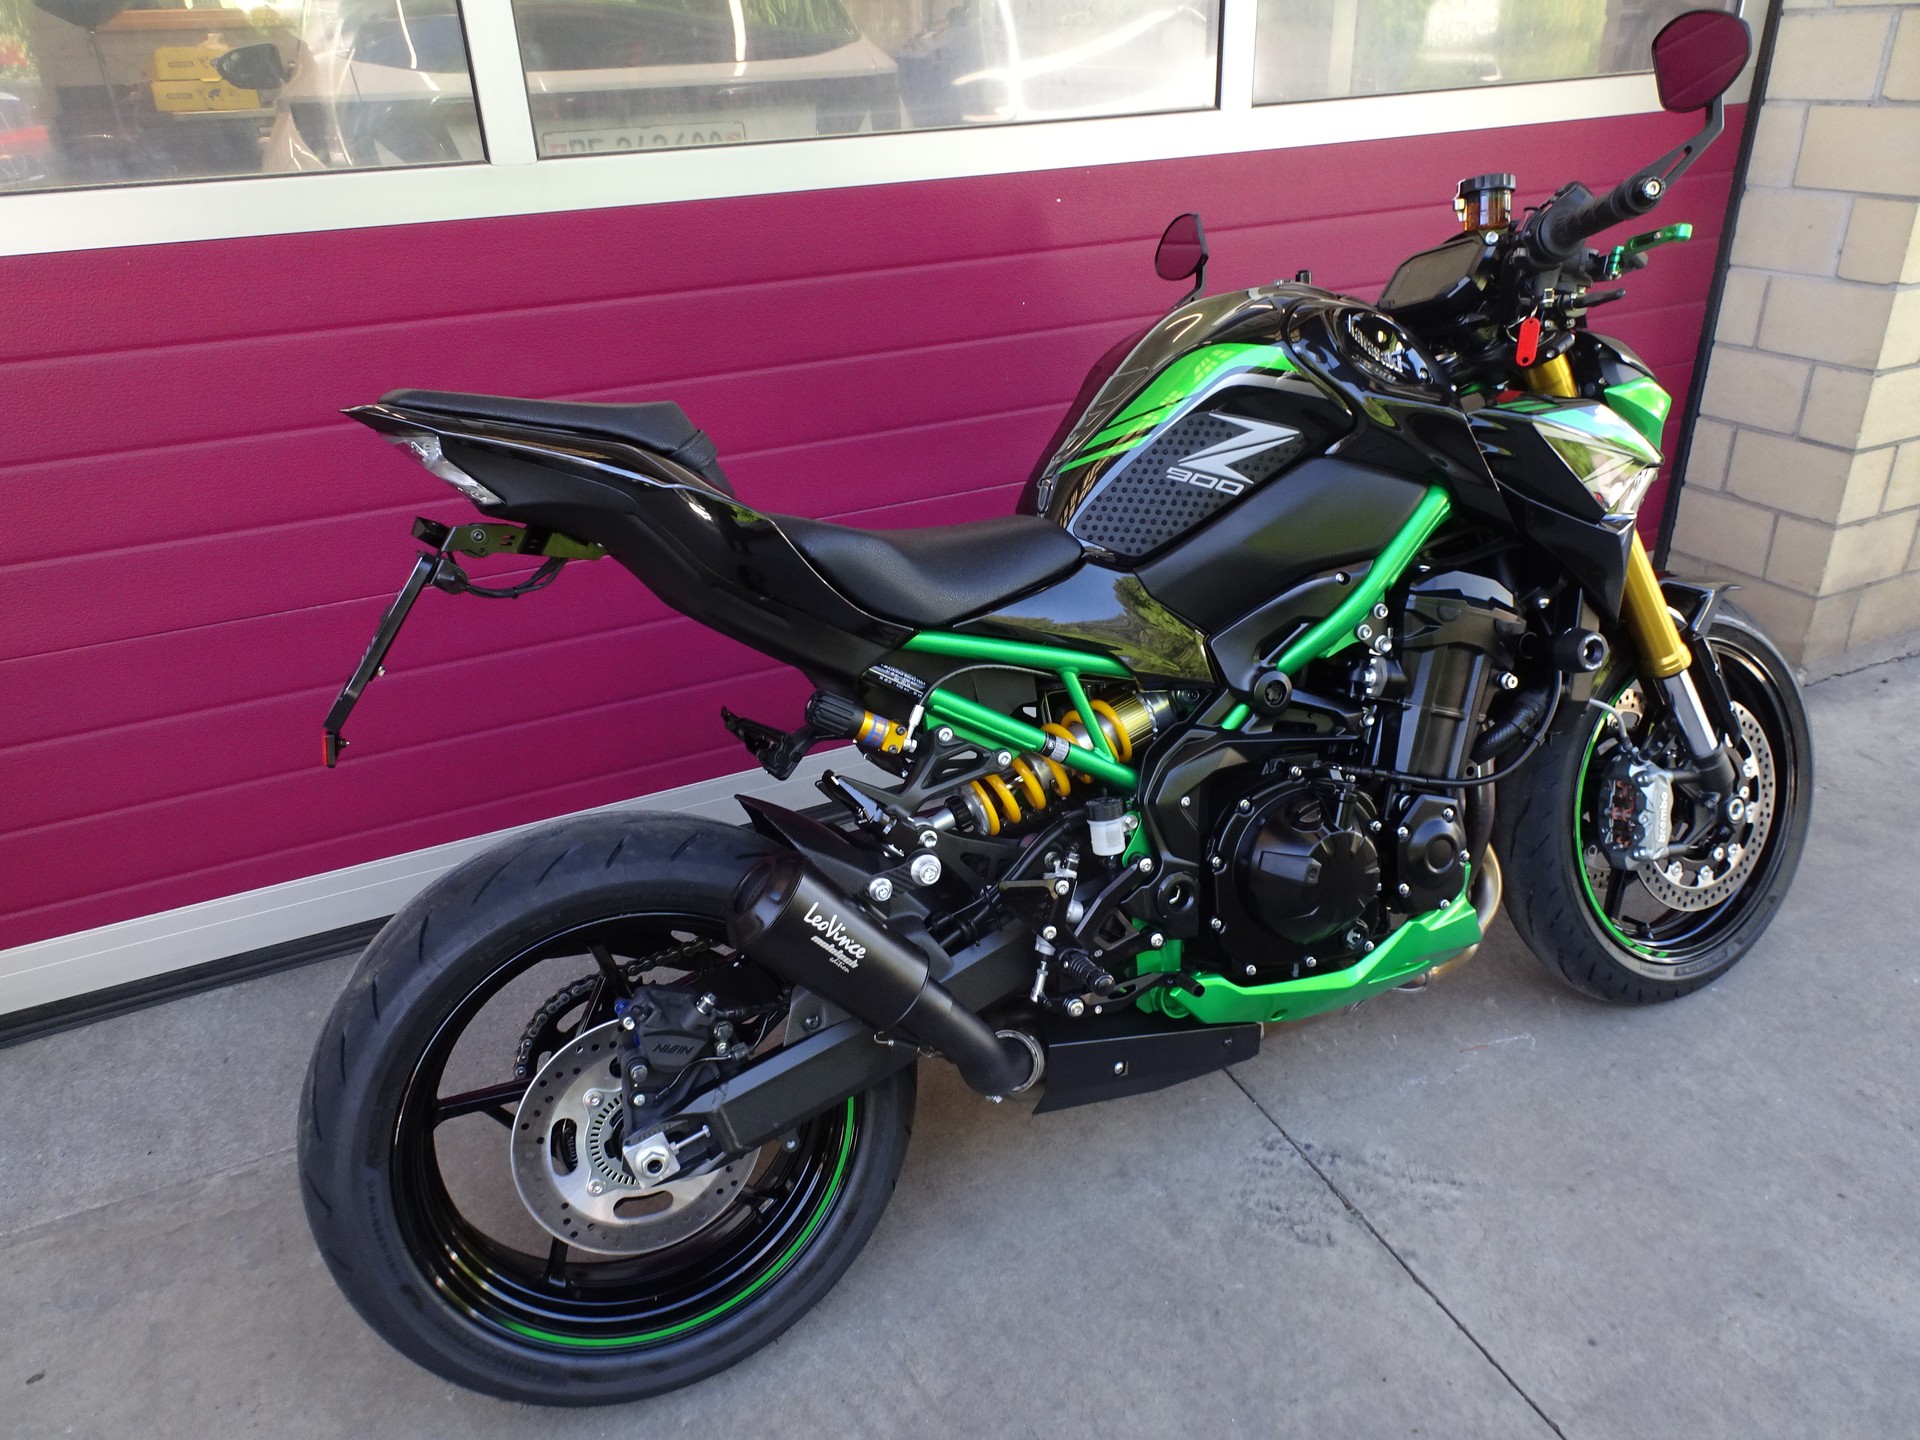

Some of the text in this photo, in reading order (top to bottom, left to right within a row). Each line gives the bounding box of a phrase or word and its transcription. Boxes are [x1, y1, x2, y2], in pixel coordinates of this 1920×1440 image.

[1177, 412, 1300, 485] Z
[1166, 466, 1245, 496] 900
[1657, 791, 1668, 843] brembo
[803, 901, 866, 959] LeoVince
